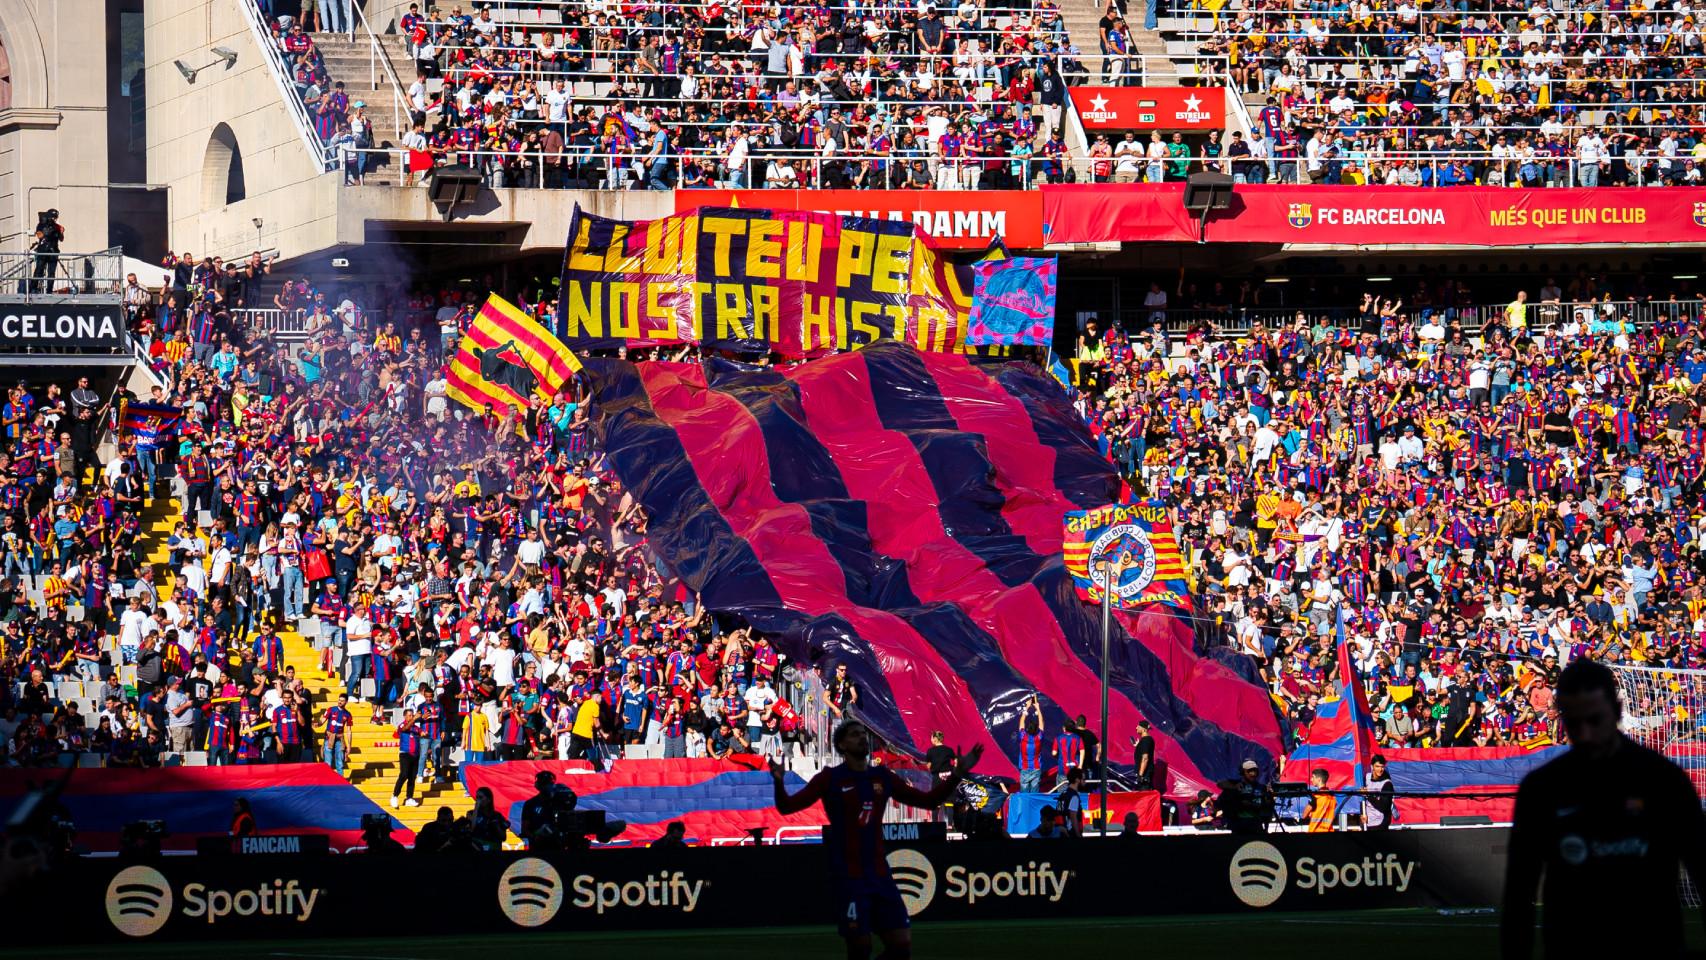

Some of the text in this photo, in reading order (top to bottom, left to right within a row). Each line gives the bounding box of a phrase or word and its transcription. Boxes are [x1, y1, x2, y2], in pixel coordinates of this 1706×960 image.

[1082, 111, 1117, 120] ESTRELLA
[1175, 111, 1211, 120] ESTRELLA
[911, 210, 1006, 238] DAMM
[1317, 208, 1446, 225] FC BARCELONA
[1490, 205, 1647, 228] MÉS QUE UN CLUB
[567, 280, 780, 343] NOSTRA
[2, 314, 118, 338] CELONA
[242, 836, 300, 853] FANCAM
[945, 861, 1069, 904] Spotify
[1295, 852, 1415, 895] Spotify
[182, 879, 319, 924] Spotify
[572, 870, 703, 914] Spotify
[847, 902, 857, 920] 4
